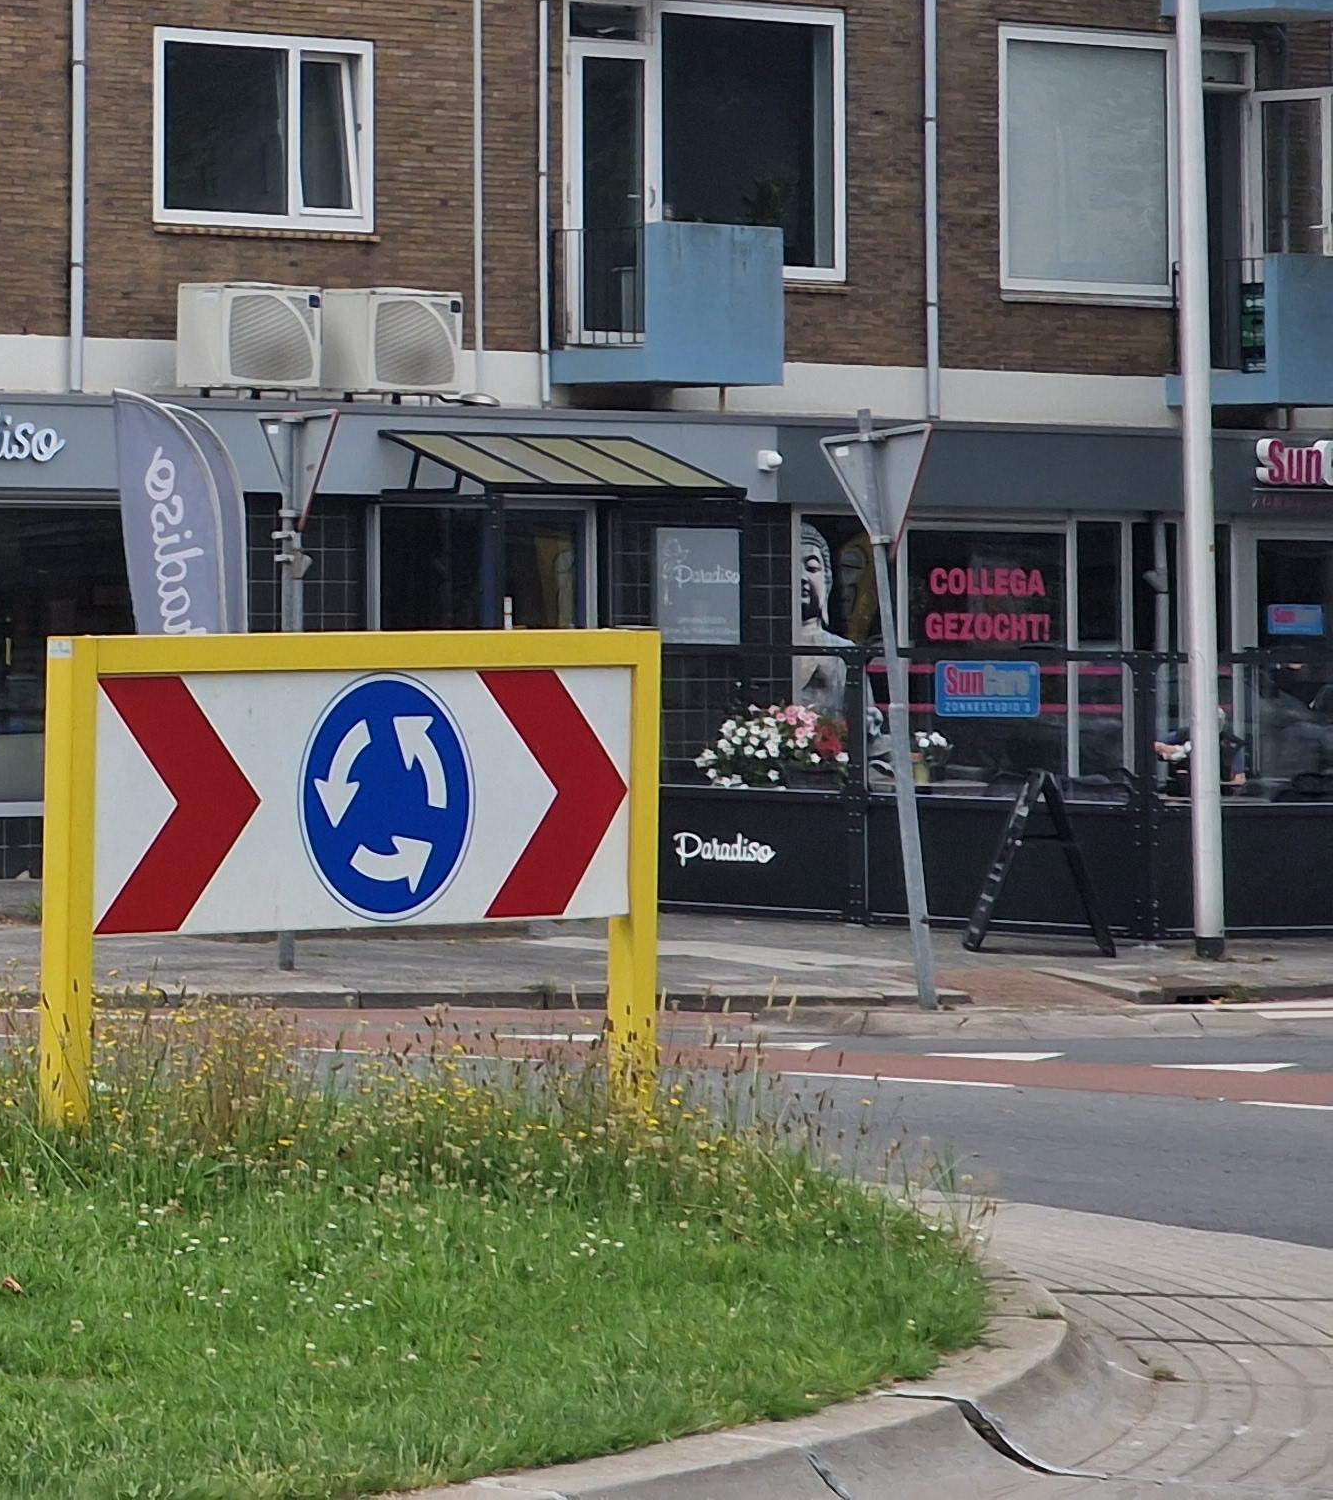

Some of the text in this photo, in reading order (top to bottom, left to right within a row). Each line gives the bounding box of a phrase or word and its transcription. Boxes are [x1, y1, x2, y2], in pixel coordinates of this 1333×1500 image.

[673, 563, 741, 588] Paradiso
[930, 567, 1046, 597] COLLEGA
[925, 612, 1051, 642] GEZOCHT!
[673, 831, 777, 867] Paradiso
